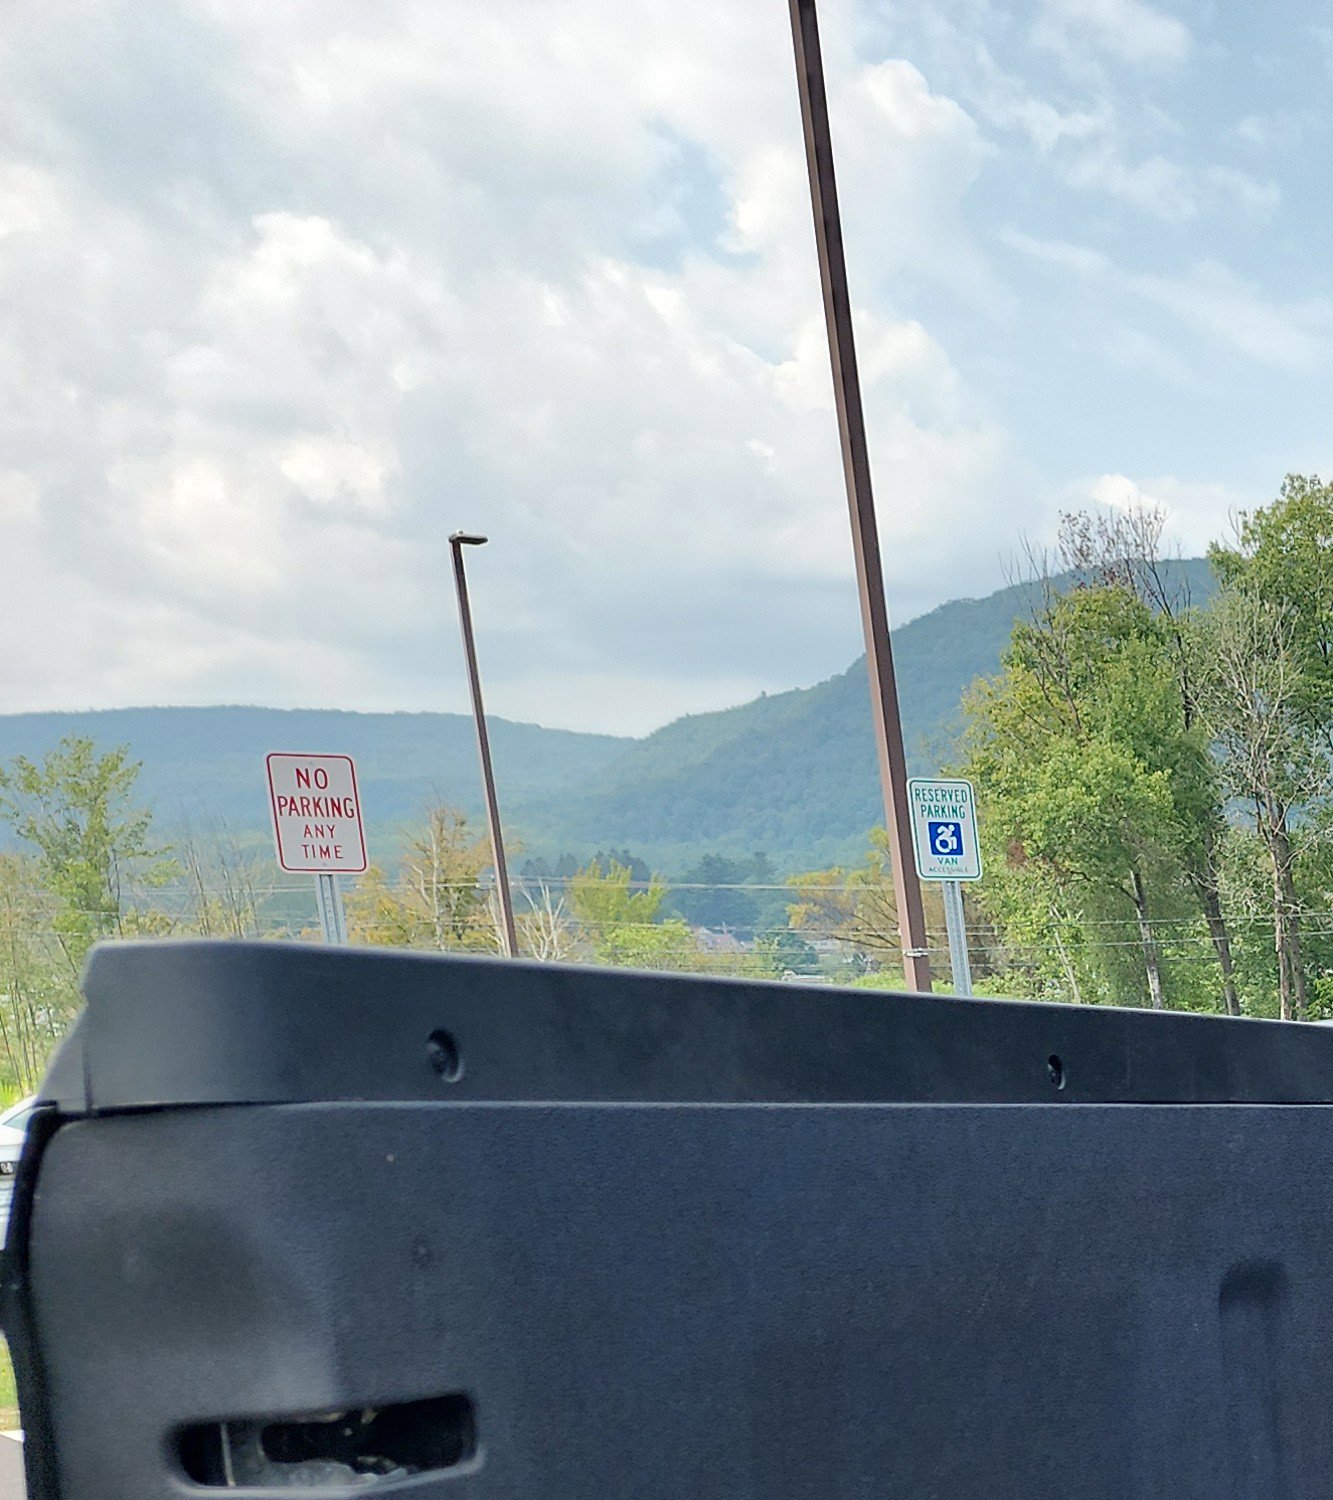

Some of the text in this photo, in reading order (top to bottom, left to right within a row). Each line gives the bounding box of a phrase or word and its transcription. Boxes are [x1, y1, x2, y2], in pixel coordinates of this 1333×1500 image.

[295, 768, 328, 789] NO
[915, 788, 968, 803] RESERVED
[277, 796, 355, 818] PARKING
[920, 804, 966, 819] PARKING
[303, 824, 336, 839] ANY
[302, 844, 344, 859] TIME
[937, 857, 958, 866] VAN
